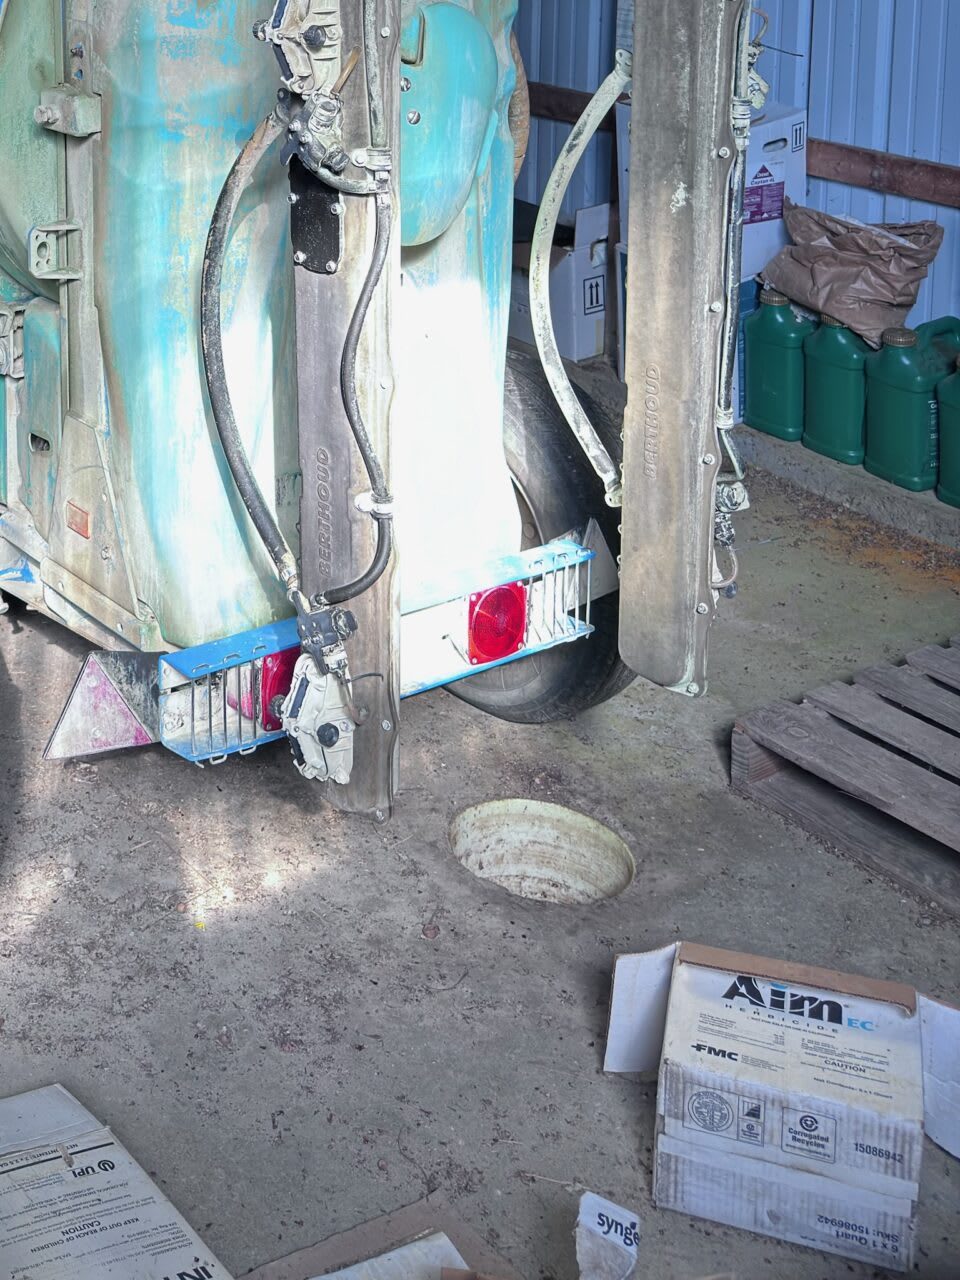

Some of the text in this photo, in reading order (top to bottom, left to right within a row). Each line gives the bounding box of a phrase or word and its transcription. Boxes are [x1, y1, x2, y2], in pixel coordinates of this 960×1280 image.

[643, 361, 659, 479] BERTHOUD
[317, 447, 330, 576] BERTHOUD
[722, 975, 842, 1025] Aim
[847, 1017, 876, 1032] EC
[691, 1043, 739, 1062] FMC
[824, 1059, 867, 1074] CAUTION
[788, 1127, 830, 1143] Corrugated
[791, 1135, 826, 1149] Recycles
[854, 1142, 905, 1164] 15086942
[71, 1164, 95, 1178] UPI
[60, 1218, 100, 1236] CAUTION
[817, 1214, 871, 1236] 15086942
[29, 1215, 138, 1254] KEEP OUT OF REACH OF CHILDREN
[835, 1230, 868, 1248] Quart
